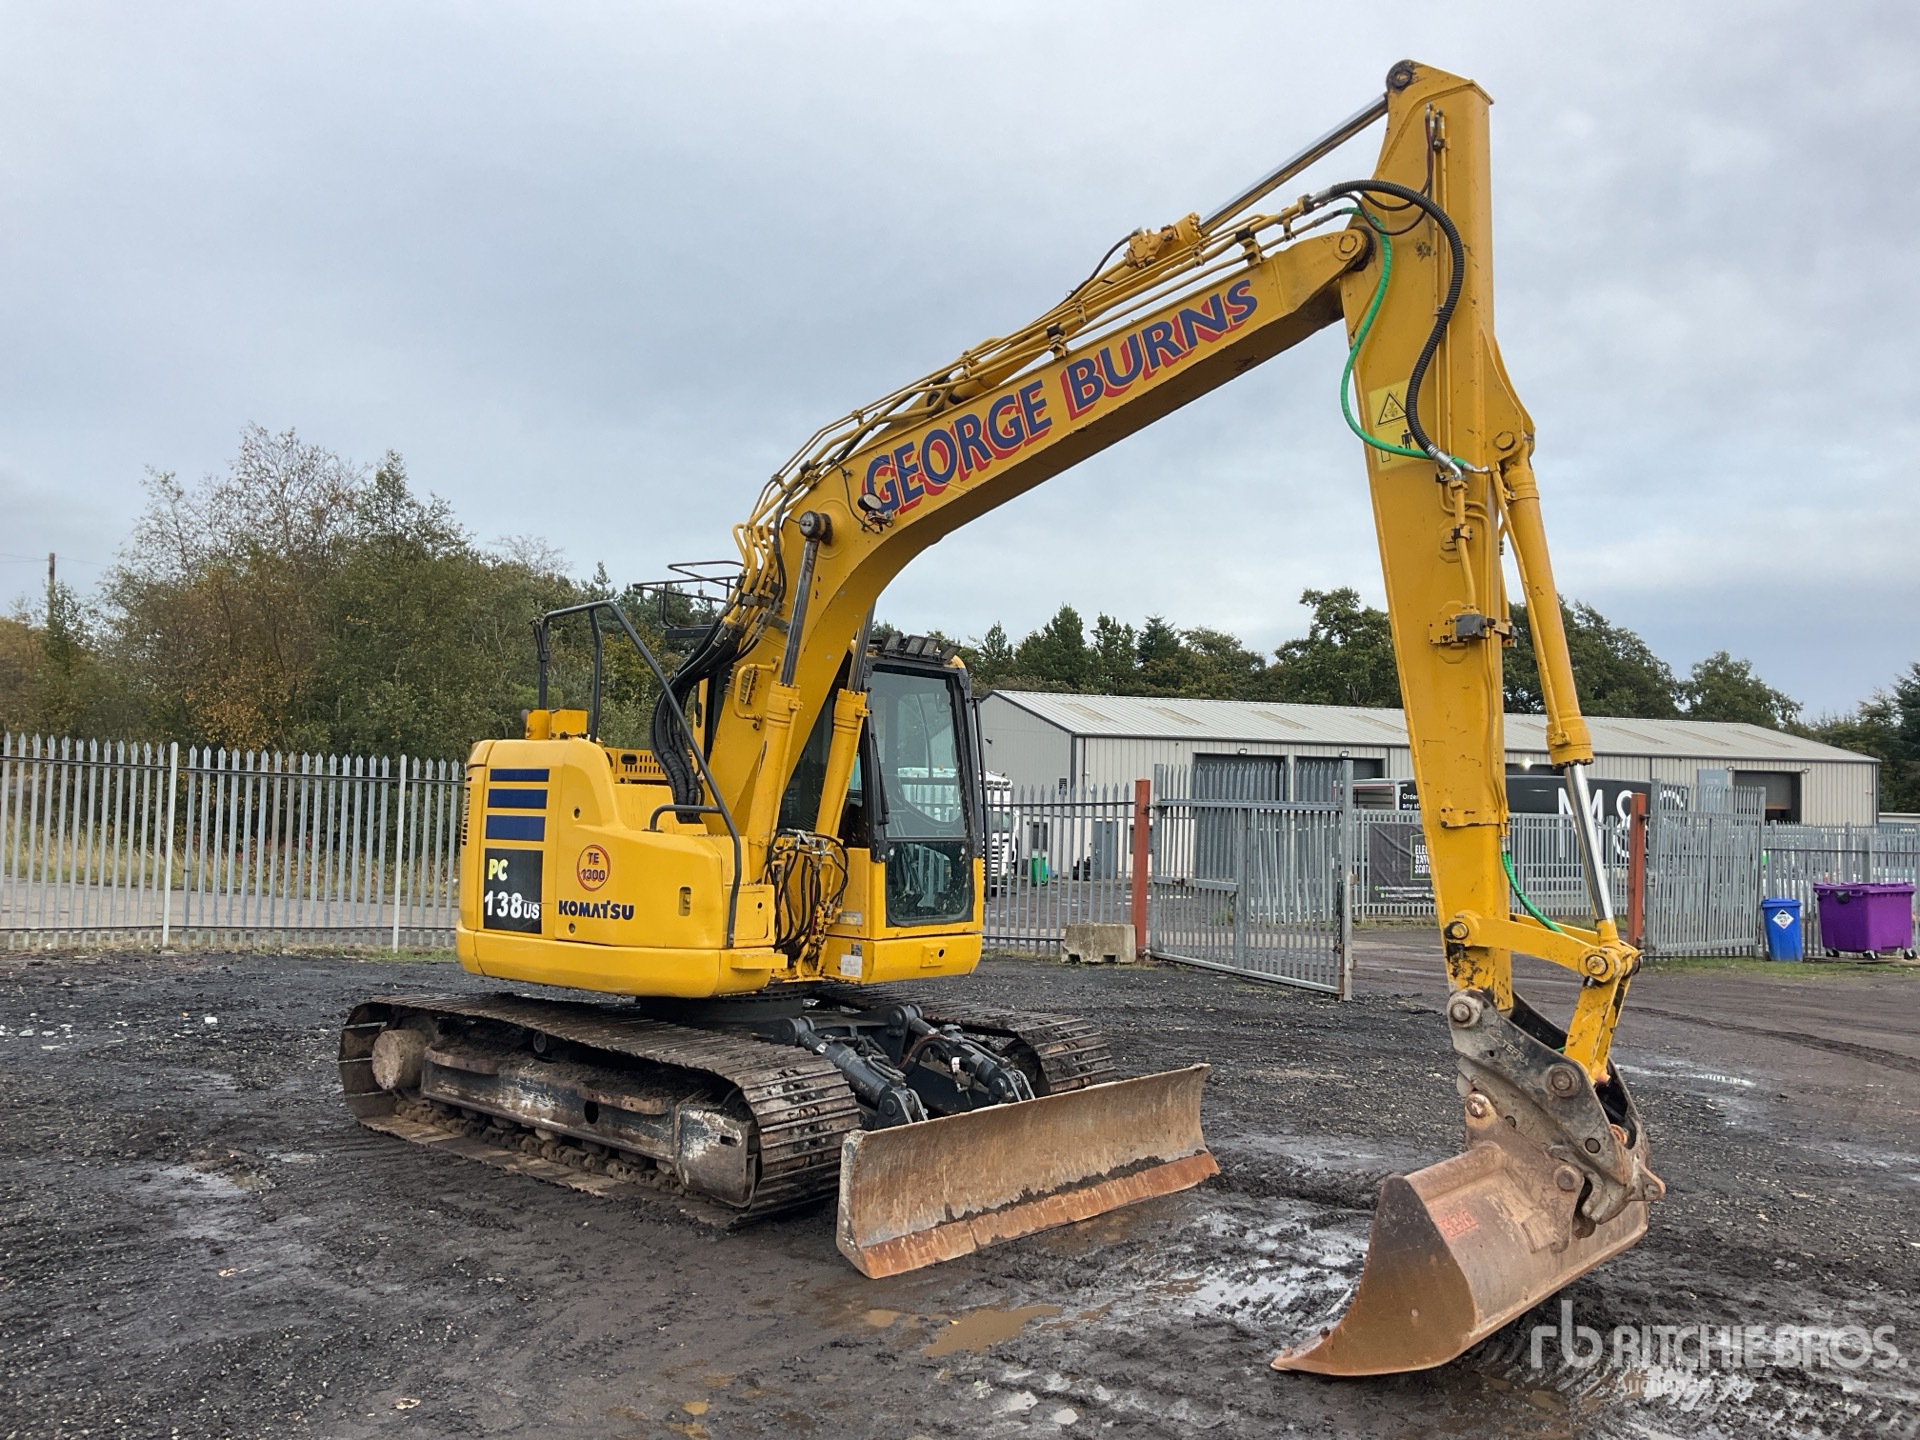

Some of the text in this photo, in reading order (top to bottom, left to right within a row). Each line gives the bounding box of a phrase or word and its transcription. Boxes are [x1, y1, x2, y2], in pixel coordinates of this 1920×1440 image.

[862, 279, 1259, 516] GEORGE BURNS
[587, 852, 600, 865] TE
[488, 858, 508, 881] PC
[581, 868, 606, 881] 1300
[558, 900, 634, 920] KOMATSU
